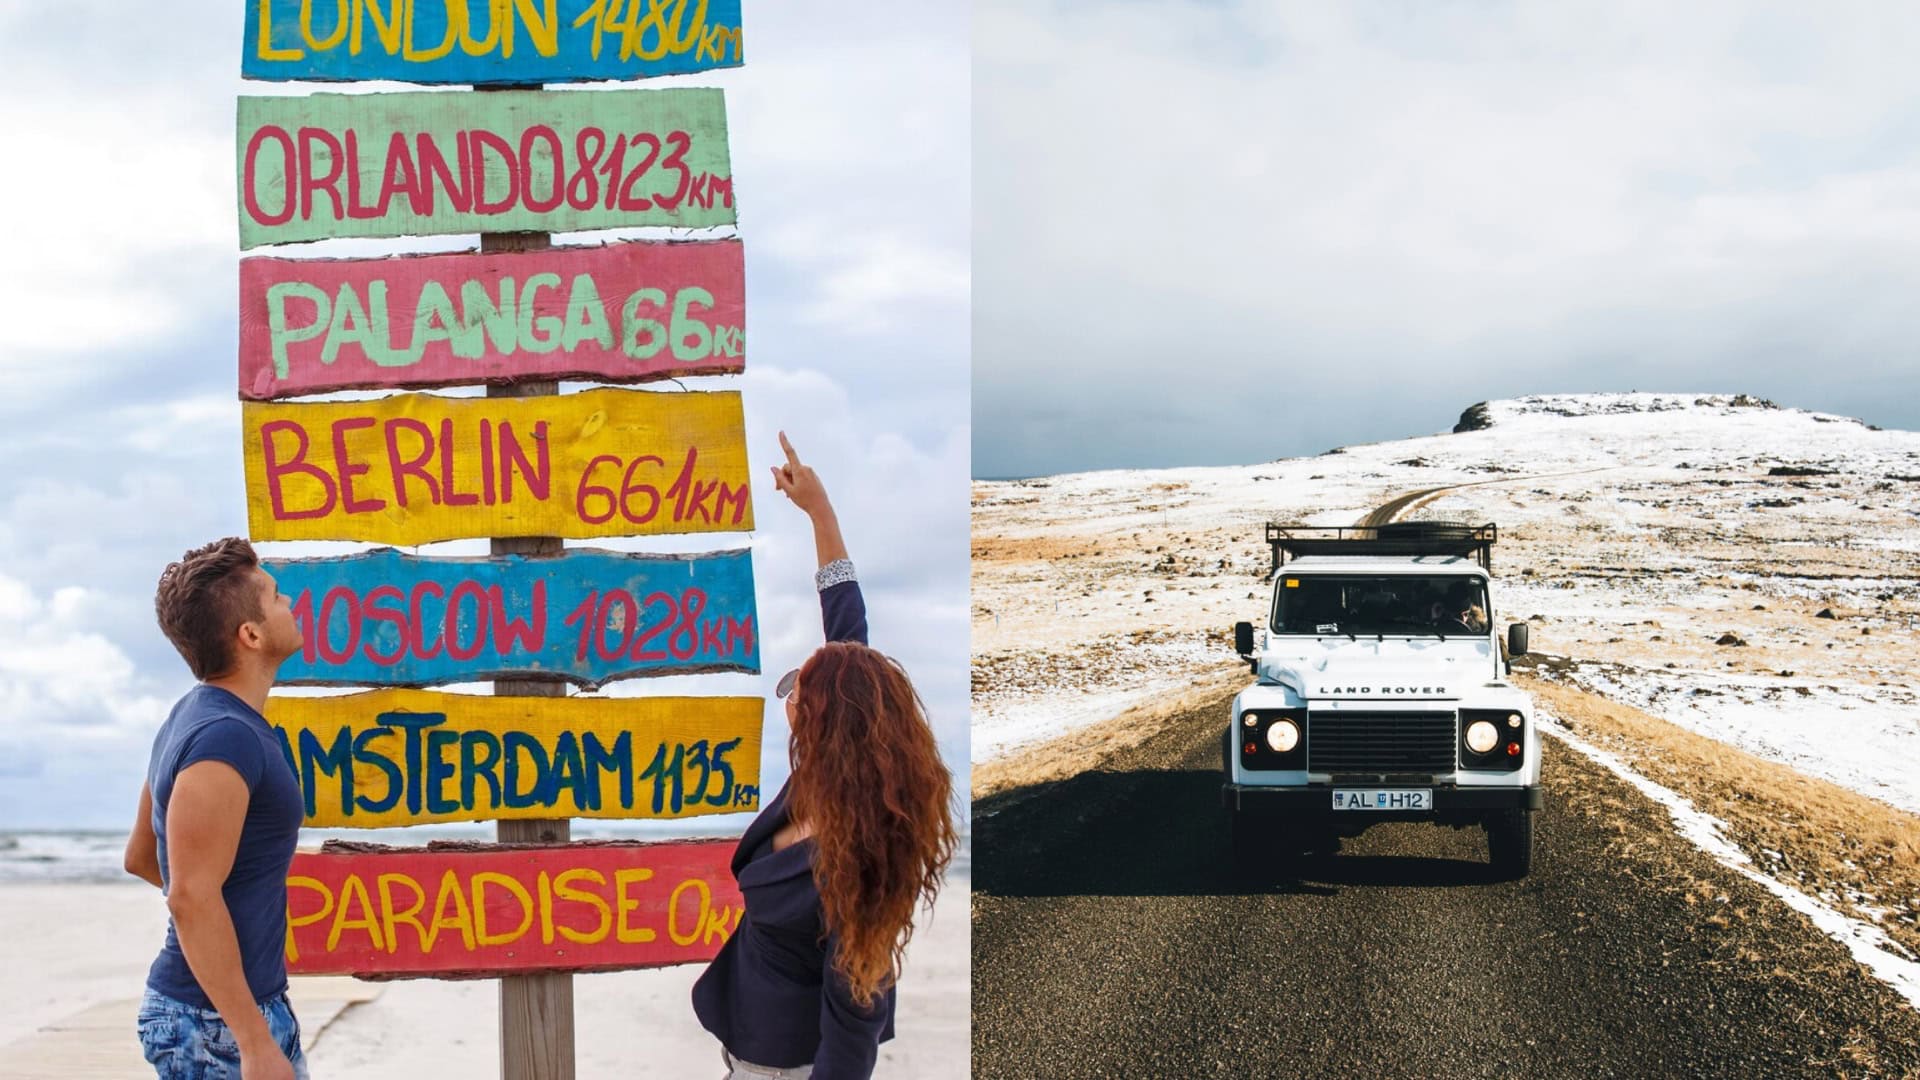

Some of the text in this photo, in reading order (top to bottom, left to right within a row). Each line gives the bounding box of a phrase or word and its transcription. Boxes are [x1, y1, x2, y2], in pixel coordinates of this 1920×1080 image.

[258, 0, 558, 62] LONDON
[244, 125, 565, 226] ORLANDO
[266, 272, 614, 380] PALANGA
[260, 417, 551, 521] BERLIN
[1348, 793, 1373, 807] AL
[1390, 793, 1423, 807] H12
[285, 868, 656, 964] PARADISE
